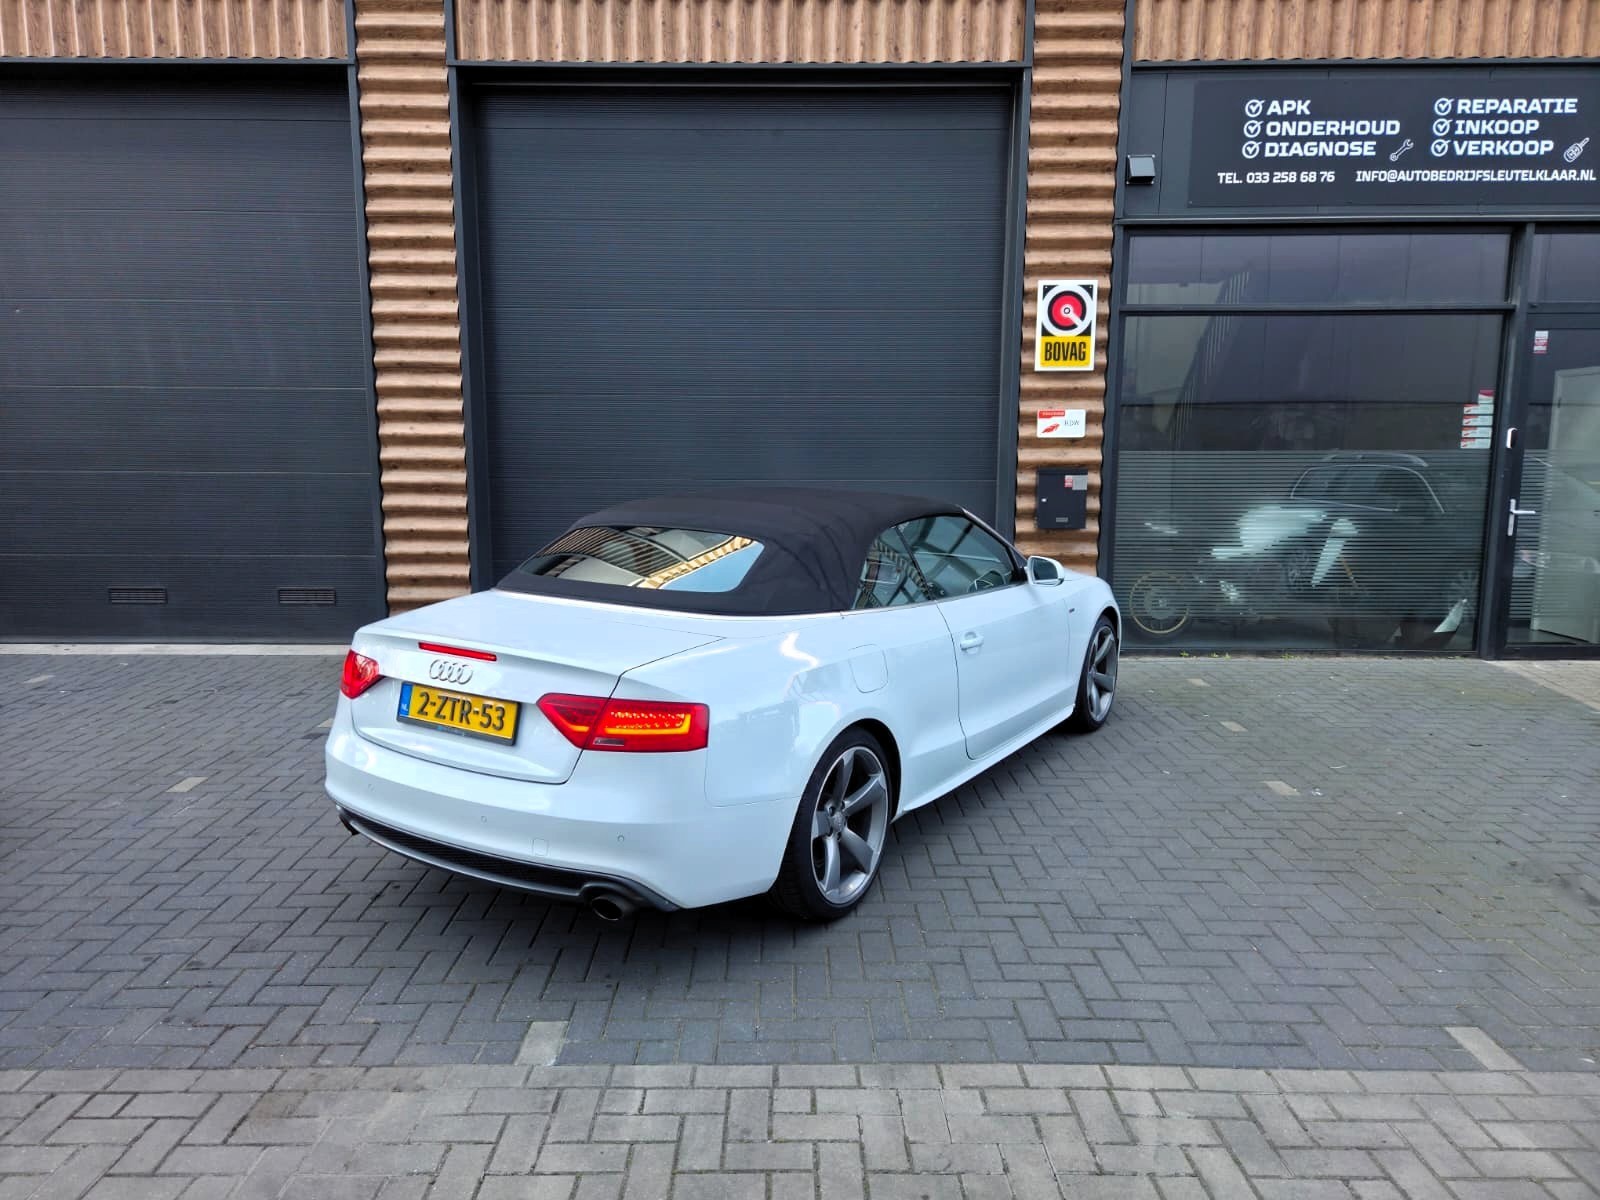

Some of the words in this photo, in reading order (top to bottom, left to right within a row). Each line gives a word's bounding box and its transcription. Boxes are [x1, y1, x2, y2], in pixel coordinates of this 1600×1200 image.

[1266, 99, 1311, 115] APK
[1457, 98, 1578, 114] REPARATIE
[1265, 120, 1401, 136] ONDERHOUD
[1454, 119, 1540, 135] INKOOP
[1264, 141, 1377, 157] DIAGNOSE
[1453, 140, 1554, 156] VERKOOP
[1217, 172, 1243, 184] TEL.
[1246, 171, 1270, 184] 033
[1273, 171, 1297, 183] 258
[1300, 171, 1317, 183] 68
[1319, 171, 1336, 183] 76
[1355, 169, 1597, 183] INFO@AUTOBEDRIJFSLEUTELKLAAR.NL
[1044, 341, 1087, 362] BOVAG
[417, 691, 506, 732] 2-ZTR-53
